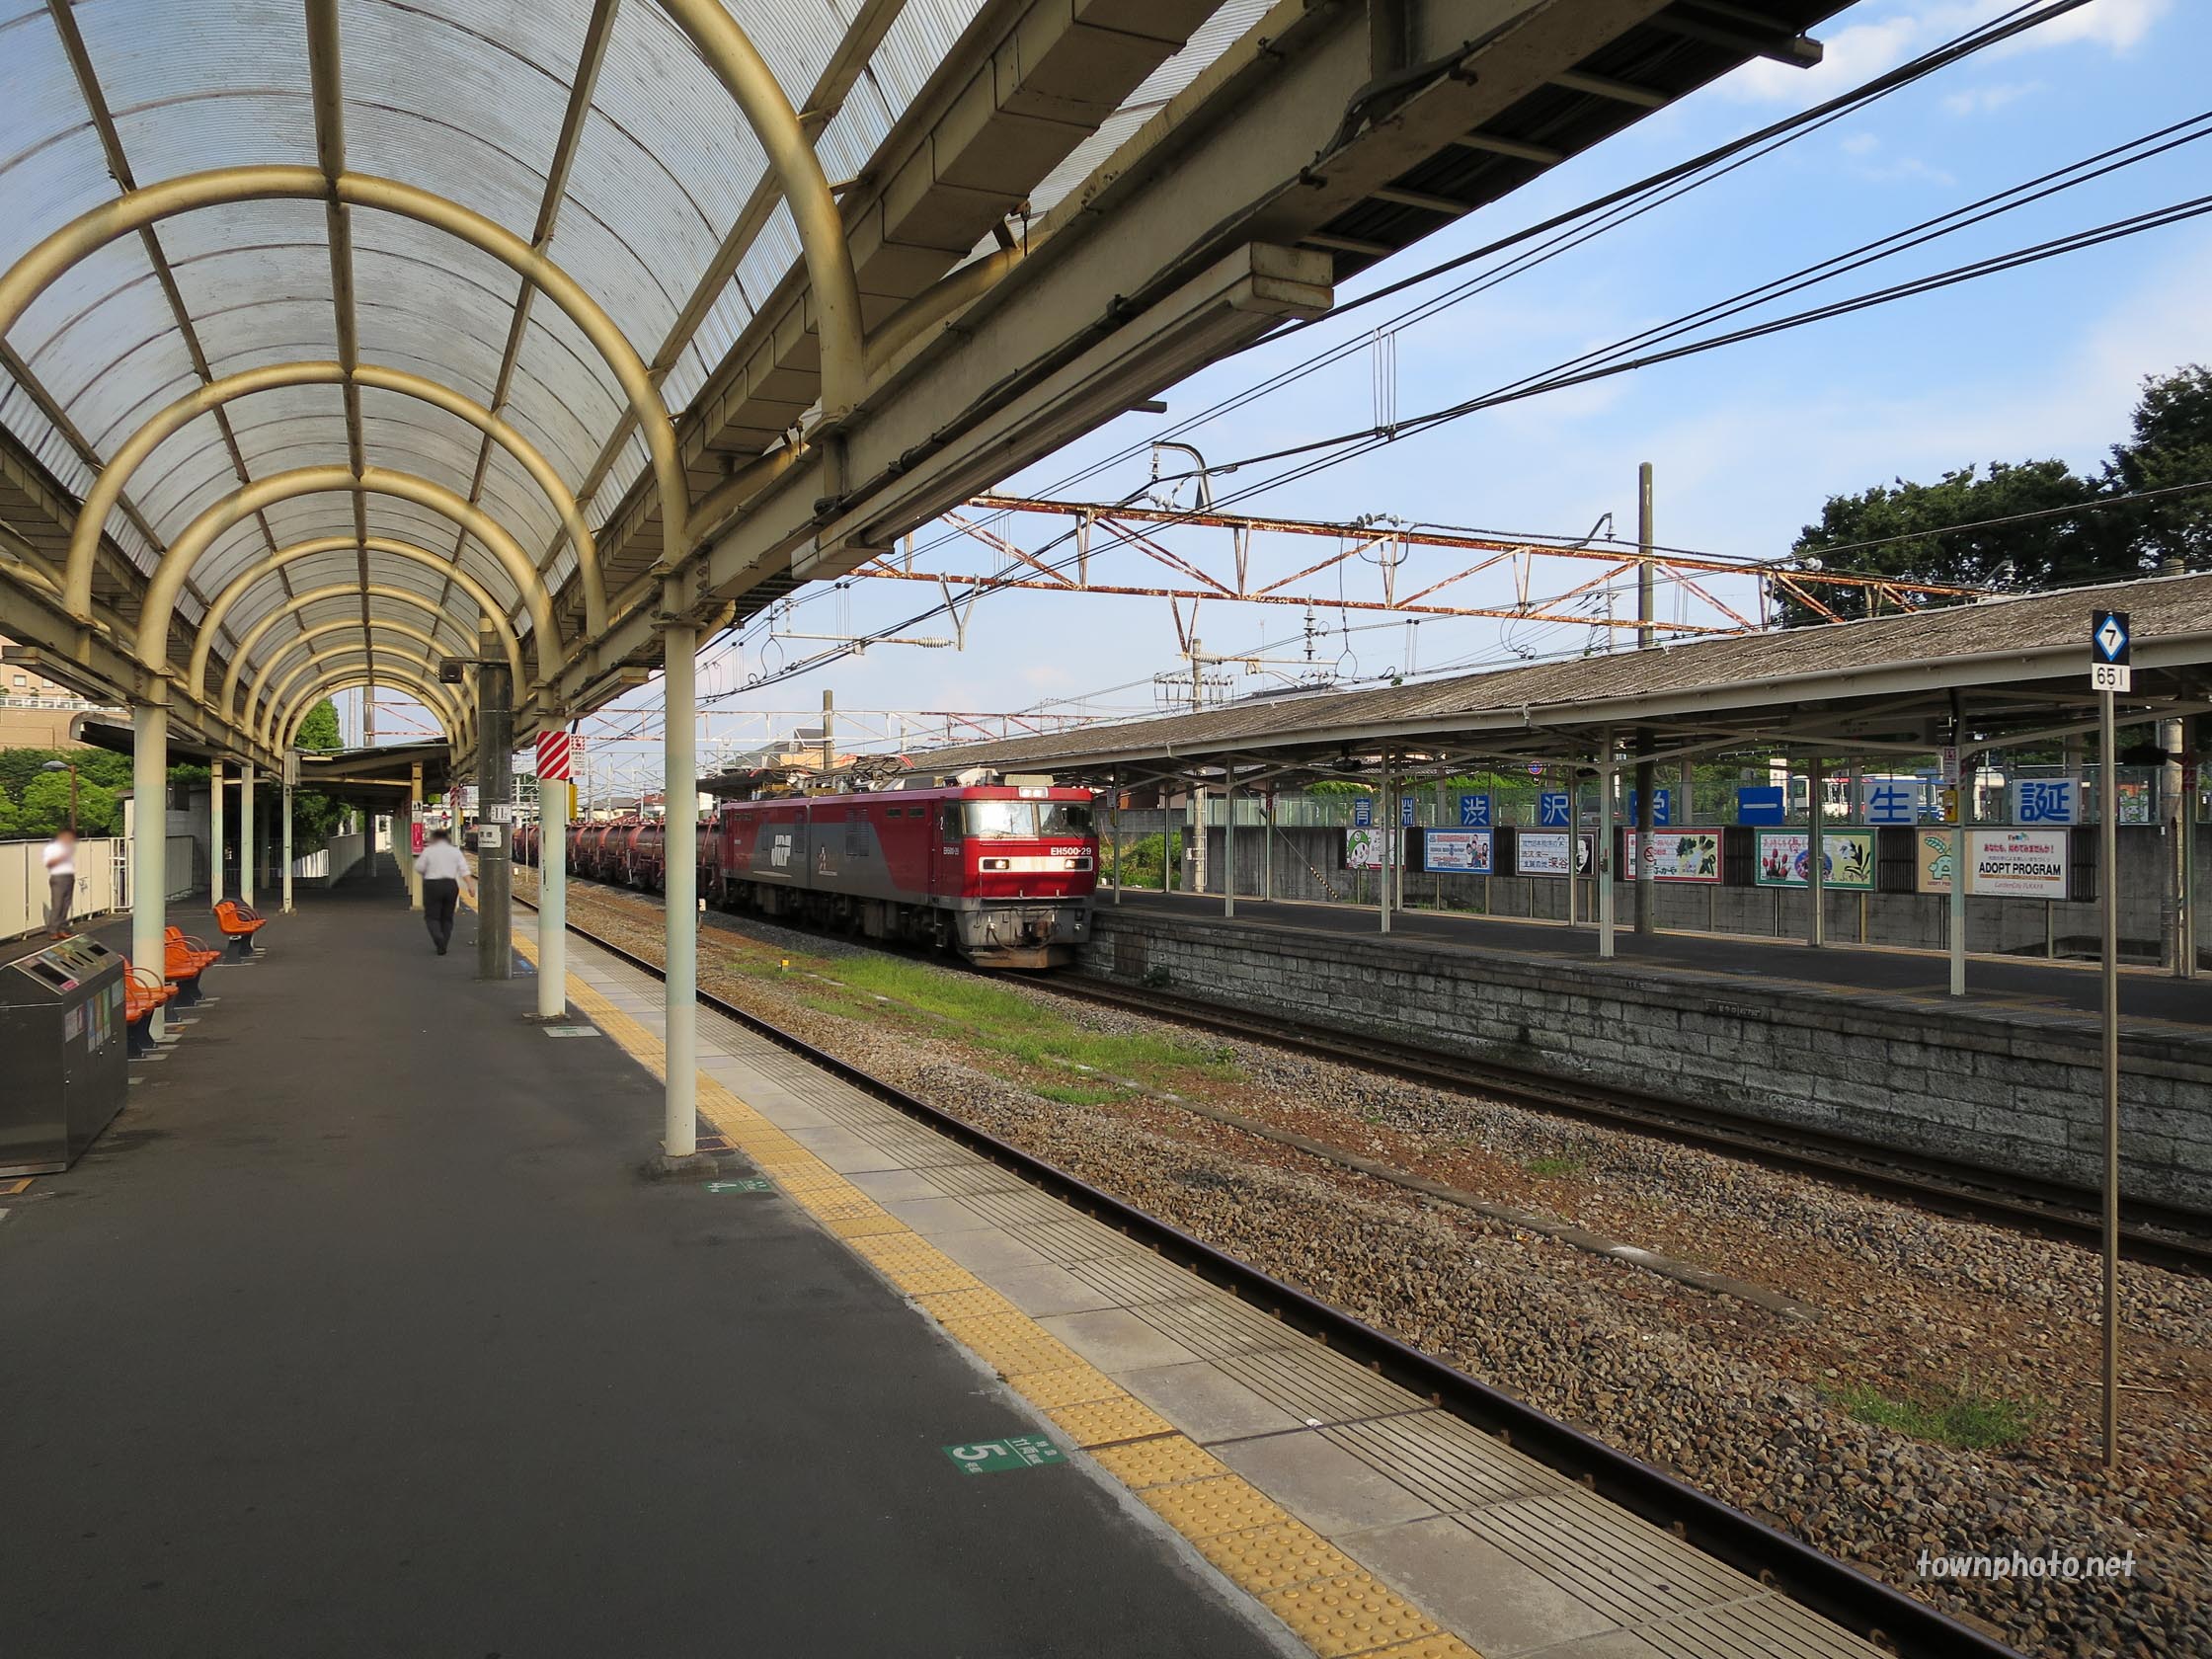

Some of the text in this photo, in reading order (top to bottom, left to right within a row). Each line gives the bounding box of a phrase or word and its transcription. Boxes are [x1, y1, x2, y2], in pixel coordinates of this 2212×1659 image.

[2104, 629, 2117, 647] 7
[2096, 667, 2123, 686] 651
[1355, 801, 1371, 826] 青
[1463, 797, 1487, 826] 渋
[1543, 795, 1570, 825] 沢
[1868, 784, 1912, 823] 生
[2019, 781, 2071, 823] 誕
[1050, 846, 1092, 856] EH500-29
[1979, 862, 2061, 876] ADOPT PROGRAM
